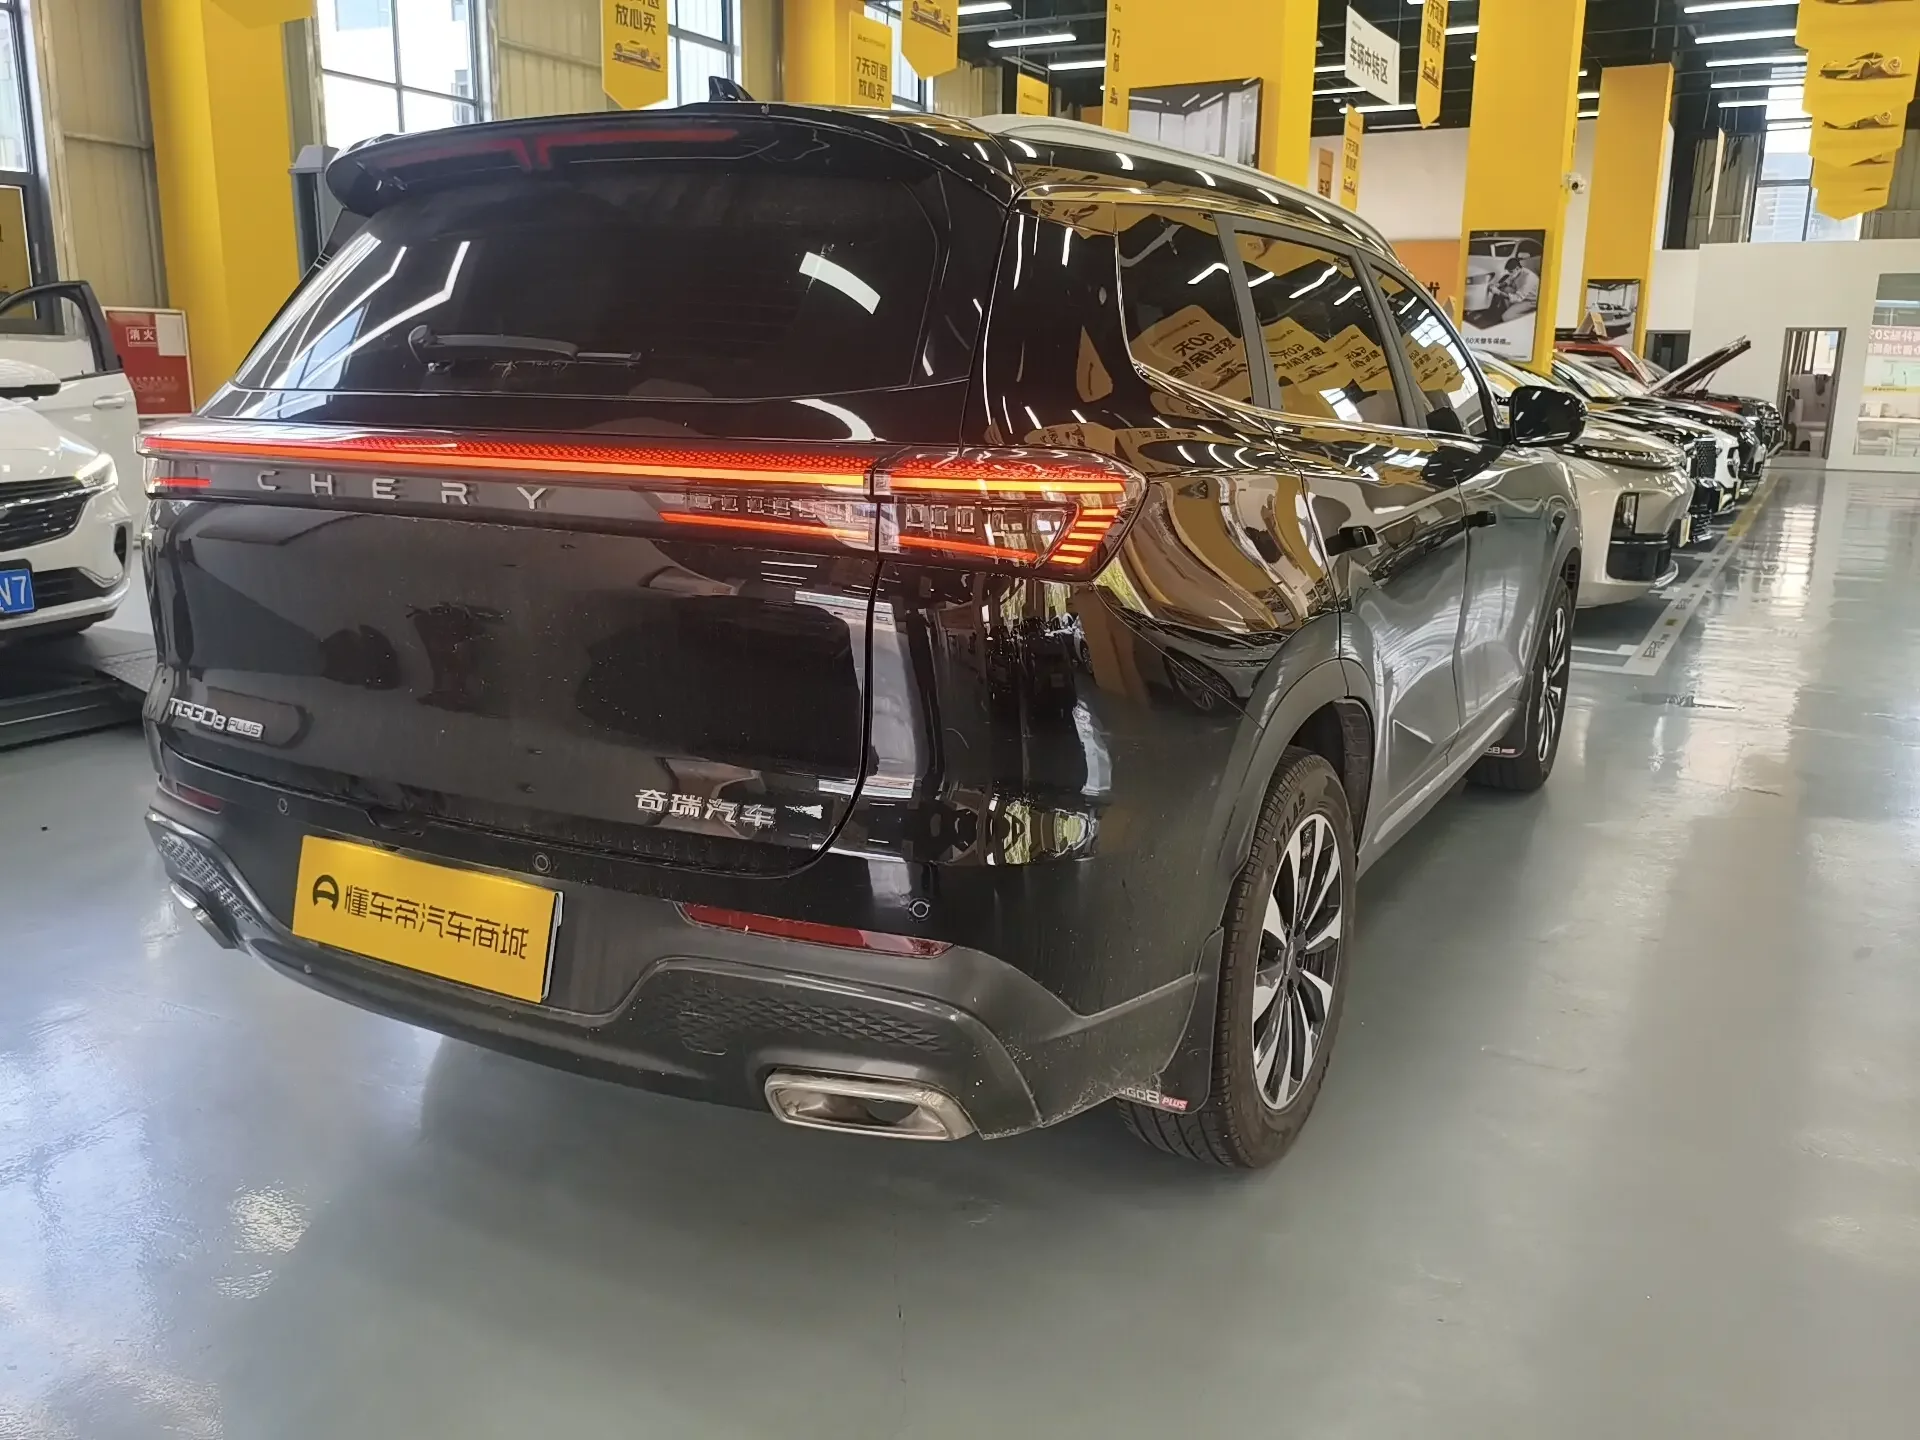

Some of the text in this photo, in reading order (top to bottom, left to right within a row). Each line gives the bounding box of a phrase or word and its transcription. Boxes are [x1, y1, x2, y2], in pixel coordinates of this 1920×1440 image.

[615, 2, 656, 35] 放心买
[856, 56, 888, 82] 7天可退
[1349, 35, 1388, 84] 车辆中转区
[858, 78, 885, 103] 放心买
[129, 329, 155, 341] 消火
[257, 470, 547, 510] CHERY
[227, 717, 263, 737] PLUS
[634, 789, 776, 829] 奇瑞汽车
[1275, 791, 1306, 863] ATLAS
[344, 885, 530, 960] 懂车帝汽车商城
[1161, 1096, 1188, 1111] PLUS
